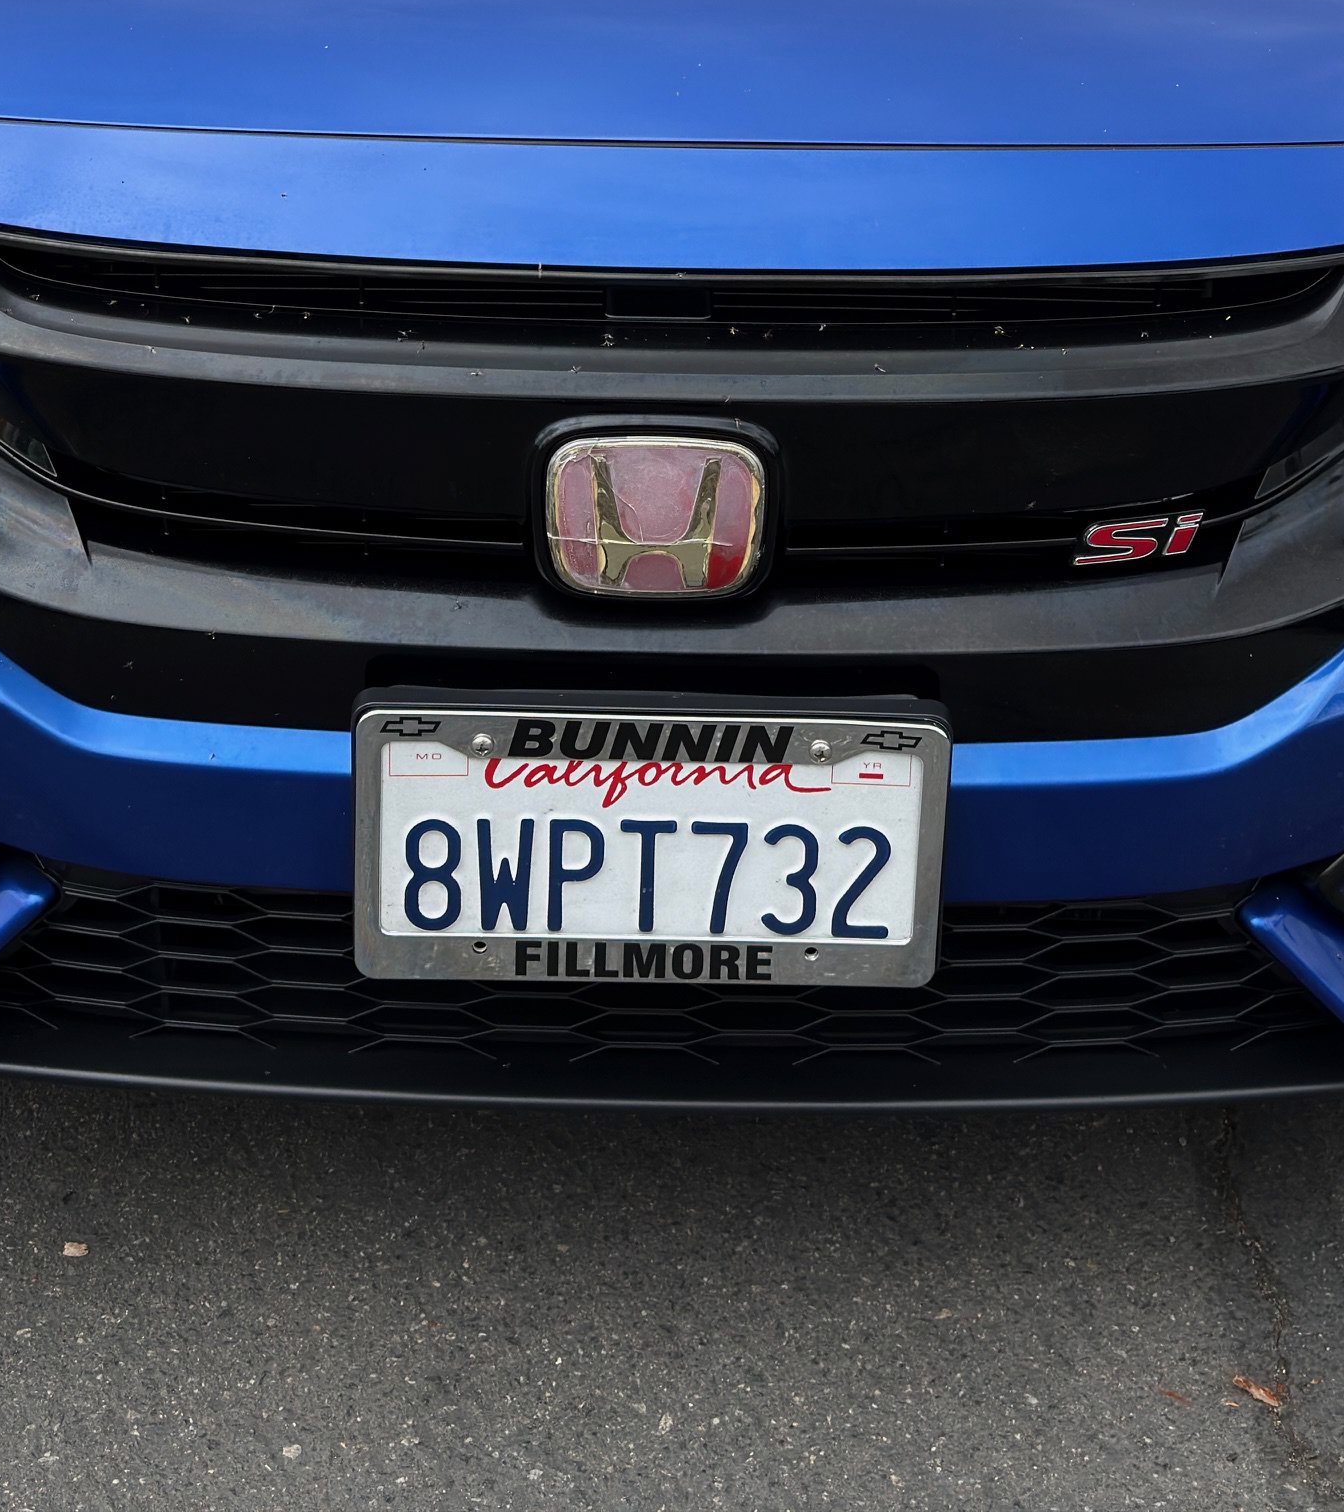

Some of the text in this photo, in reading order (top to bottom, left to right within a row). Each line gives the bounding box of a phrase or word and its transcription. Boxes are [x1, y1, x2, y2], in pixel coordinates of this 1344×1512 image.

[1073, 512, 1204, 566] Si
[507, 719, 795, 764] BUNNIN
[862, 761, 883, 769] YR
[484, 758, 832, 808] California
[404, 818, 892, 940] 8WPT732
[515, 941, 773, 982] FILLMORE
